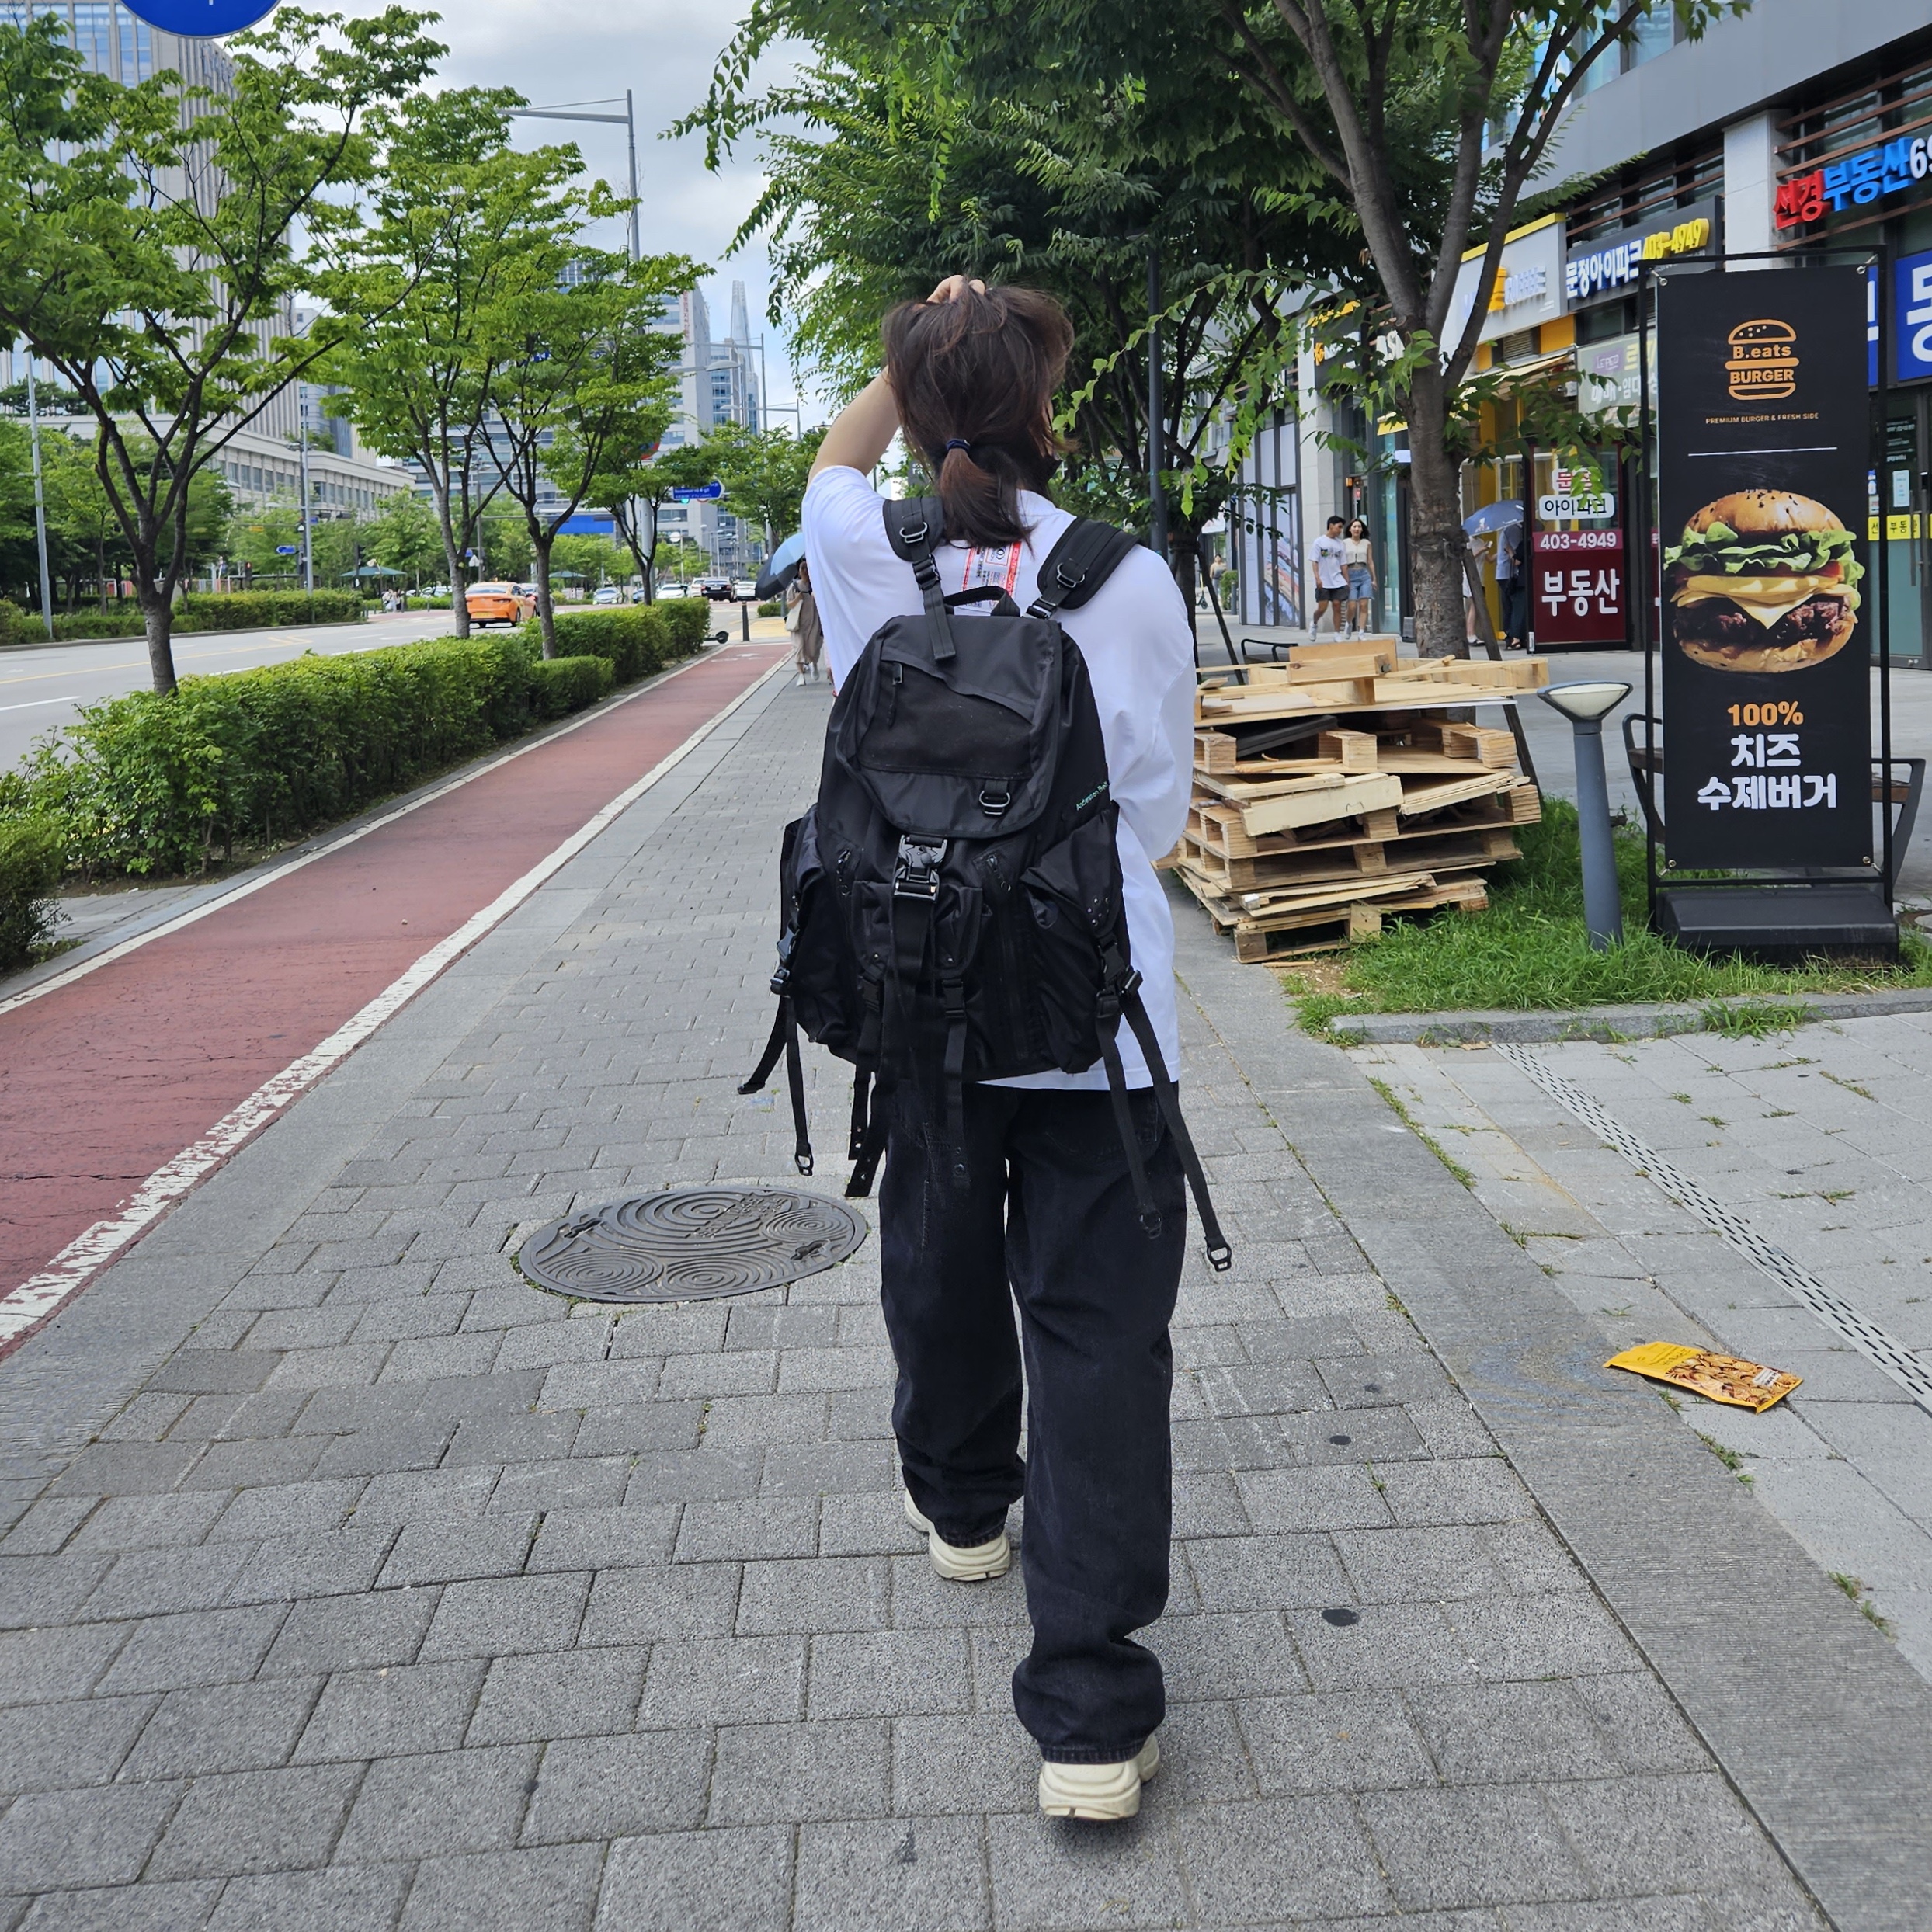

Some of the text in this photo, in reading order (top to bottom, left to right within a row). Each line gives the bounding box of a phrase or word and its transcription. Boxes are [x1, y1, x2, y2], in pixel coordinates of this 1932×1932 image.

[1732, 345, 1792, 360] B.eats
[1730, 368, 1795, 384] BURGER
[1740, 415, 1770, 423] BURGER
[1540, 532, 1617, 550] 403-4949
[1541, 568, 1620, 617] 부동산
[1727, 700, 1805, 727] 100%
[1730, 733, 1802, 768] 치즈
[1697, 773, 1837, 811] 수제버거
